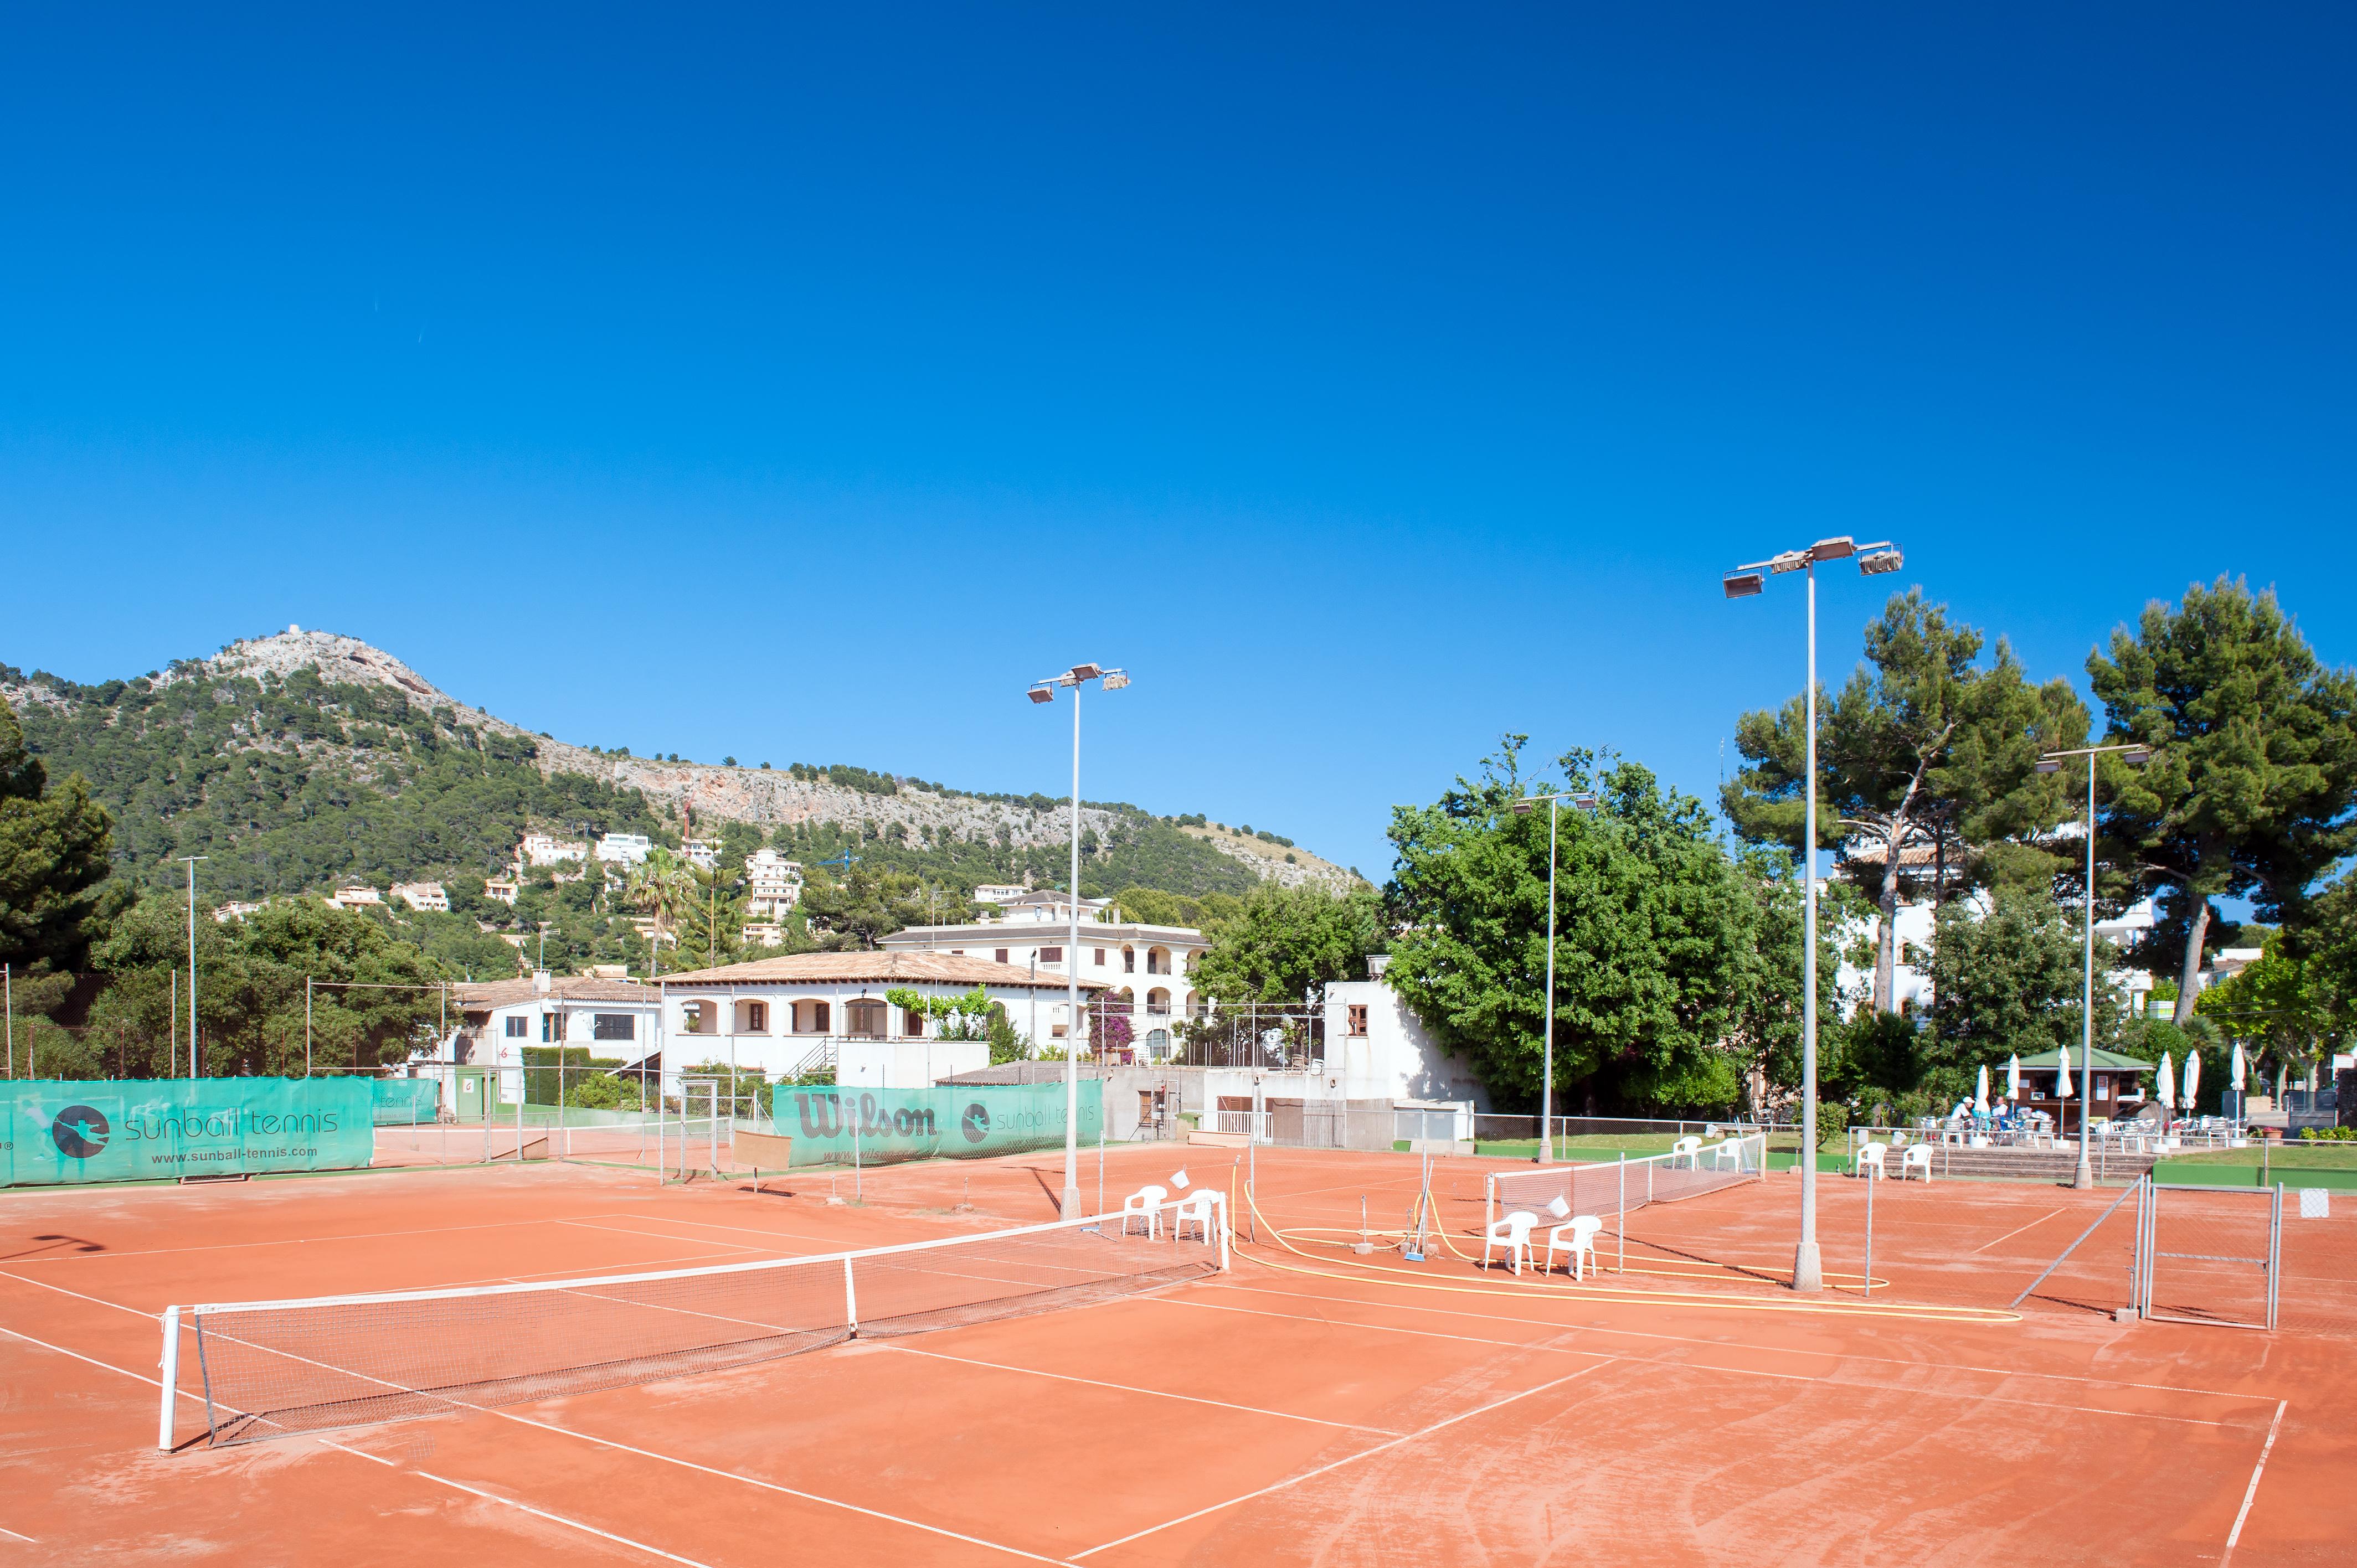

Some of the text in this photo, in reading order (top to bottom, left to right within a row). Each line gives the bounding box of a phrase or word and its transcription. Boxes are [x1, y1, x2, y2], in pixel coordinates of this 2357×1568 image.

[380, 1095, 422, 1107] tenns
[125, 1107, 338, 1141] sunball tennis
[794, 1092, 938, 1139] Wilson
[997, 1102, 1094, 1130] sunball tenis
[151, 1147, 318, 1164] www.sunball-tennis.com
